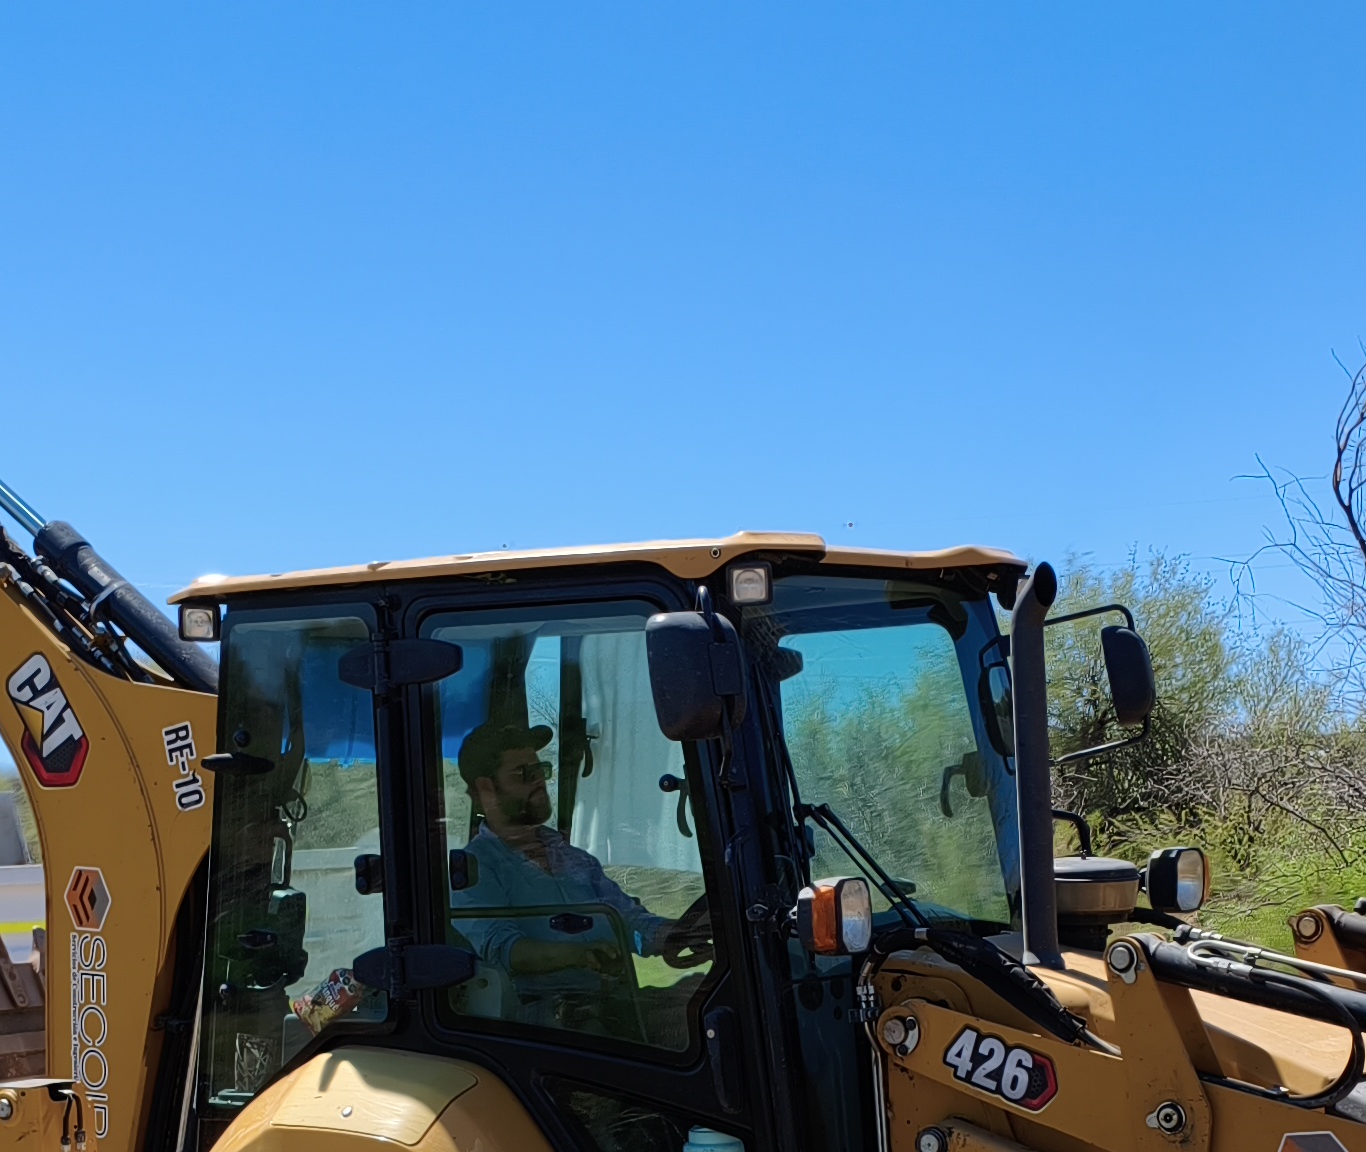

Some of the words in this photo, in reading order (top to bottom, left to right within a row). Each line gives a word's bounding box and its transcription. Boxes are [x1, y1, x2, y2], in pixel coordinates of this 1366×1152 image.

[9, 654, 83, 757] CAT
[163, 722, 204, 810] RE-10
[79, 935, 107, 1136] SECOIP
[946, 1028, 1033, 1100] 426
